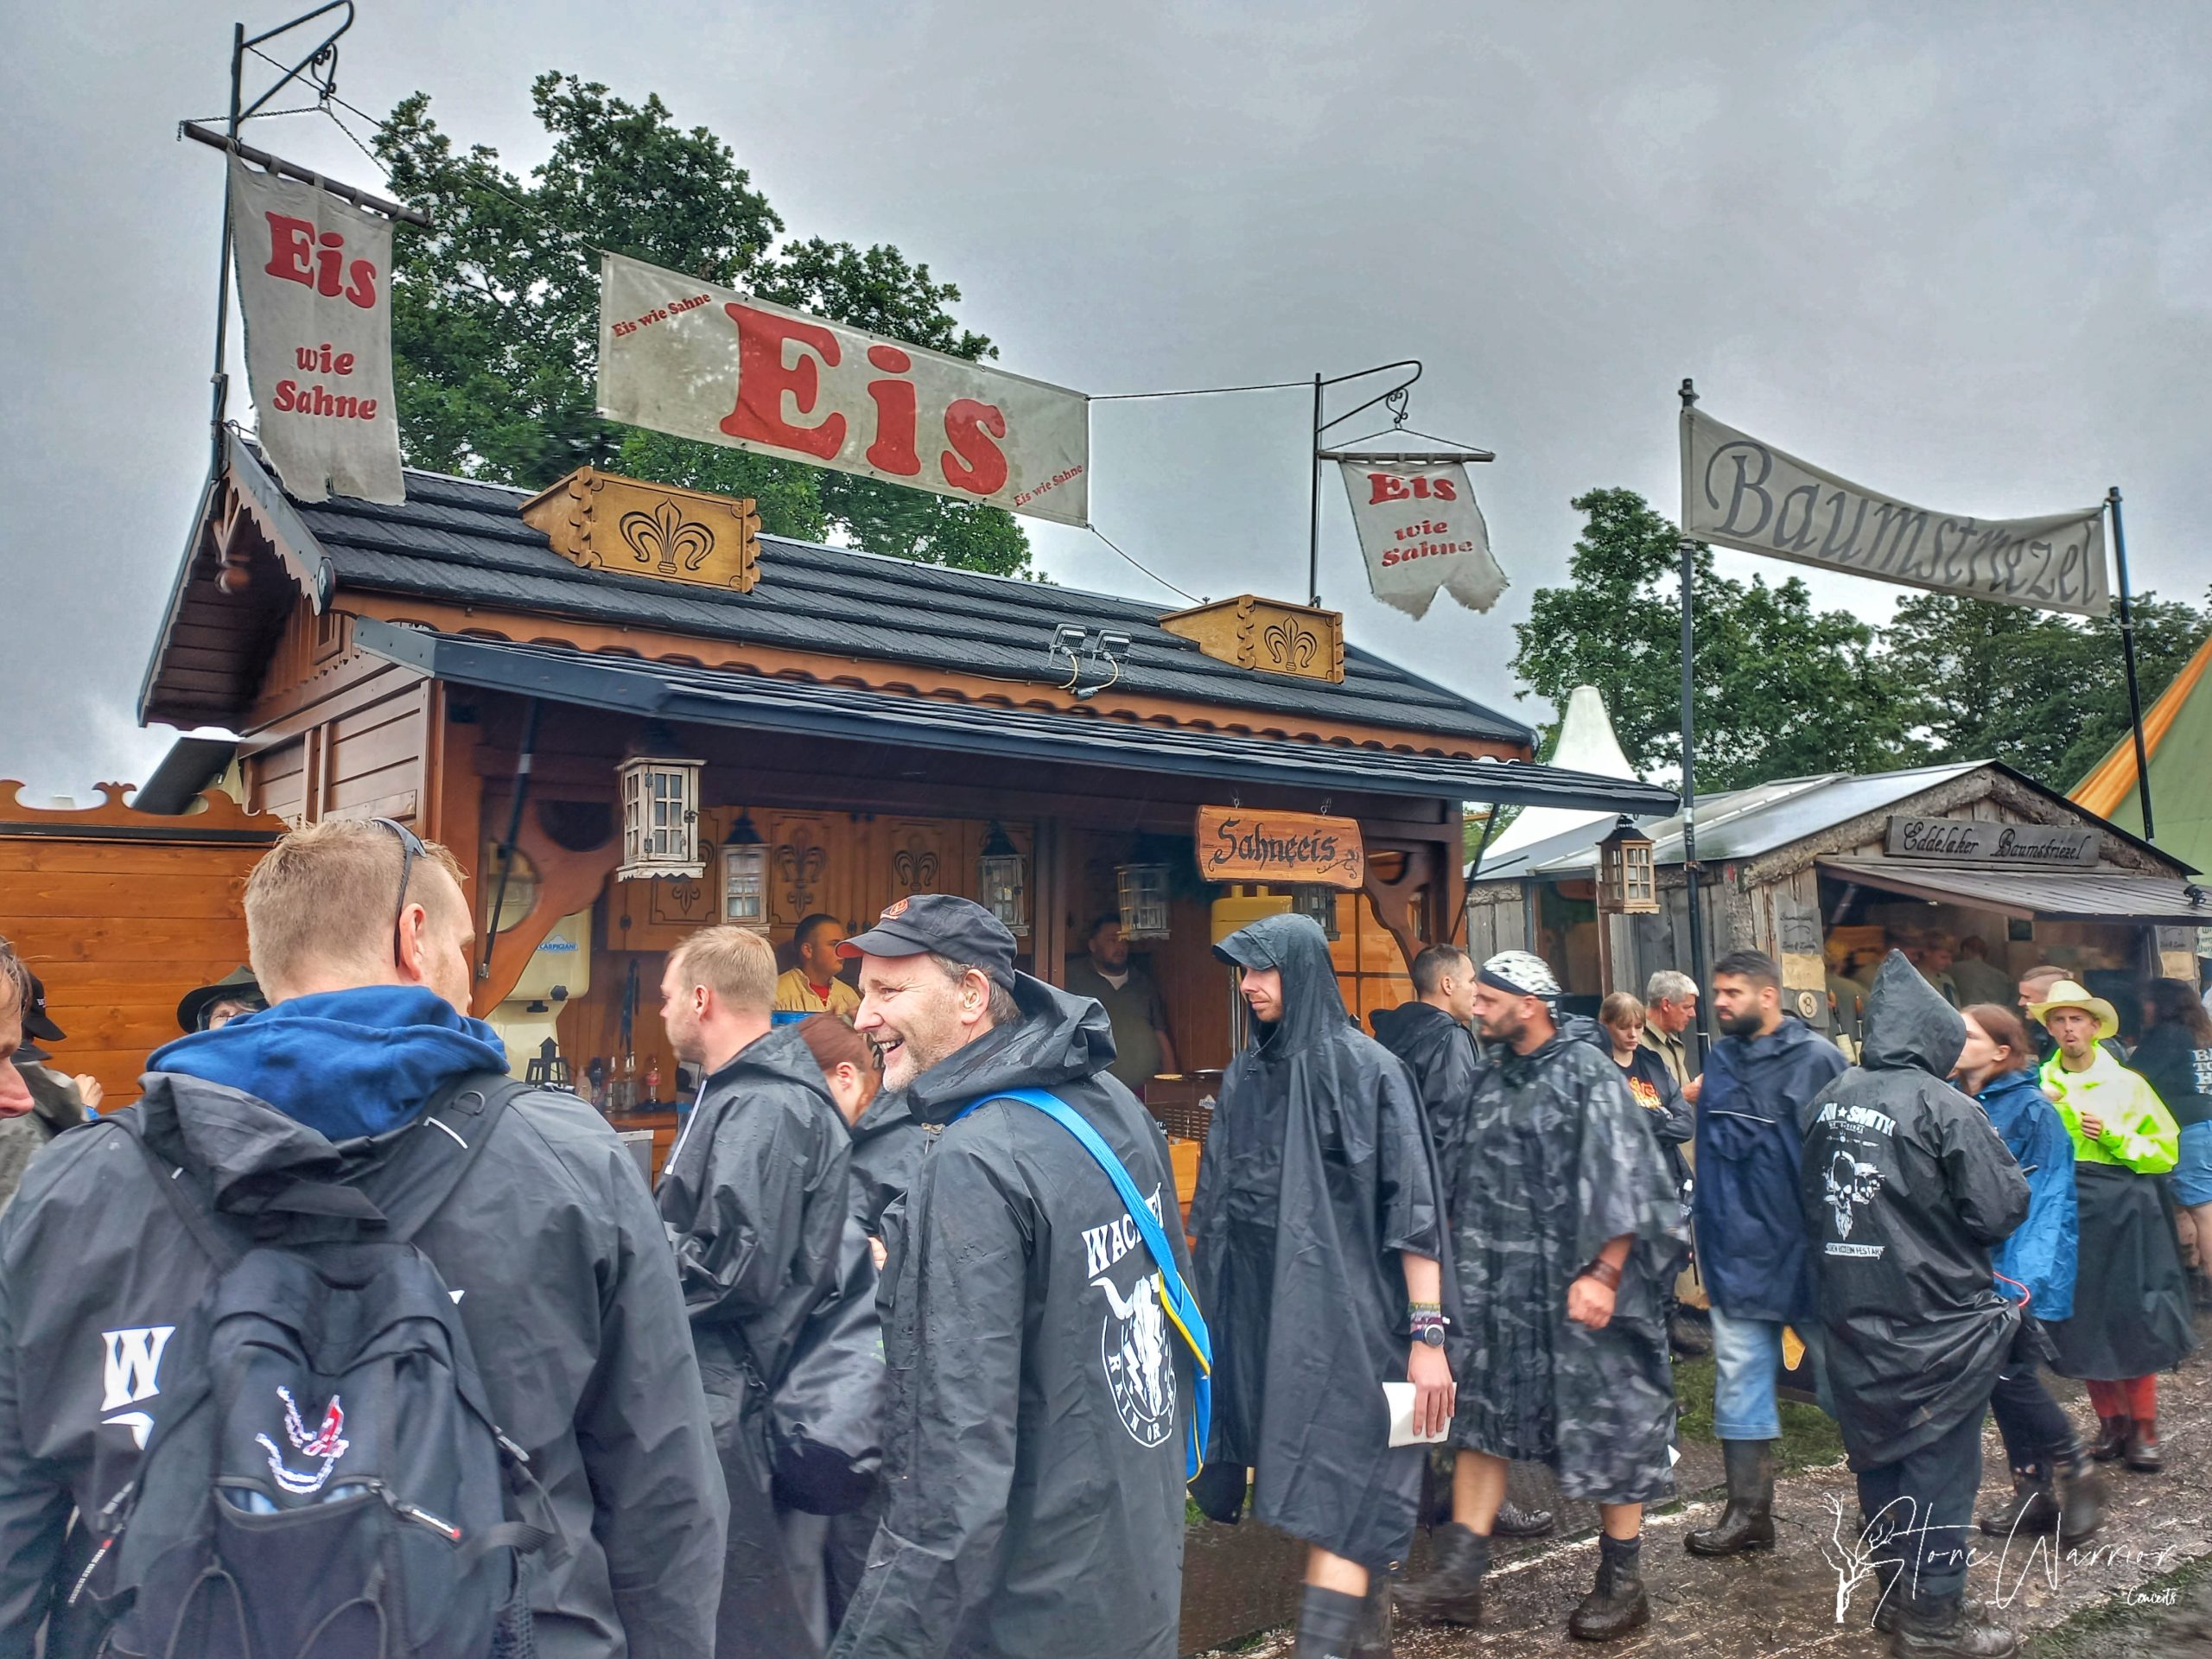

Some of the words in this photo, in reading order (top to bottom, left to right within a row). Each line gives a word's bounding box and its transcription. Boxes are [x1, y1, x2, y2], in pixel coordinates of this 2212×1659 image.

[264, 211, 377, 308] Eis
[611, 321, 637, 337] Eis
[638, 309, 667, 326] wie
[667, 294, 711, 315] Sahne
[295, 344, 354, 375] wie
[272, 379, 378, 420] Sahne
[720, 302, 1007, 495] Eis
[1013, 493, 1032, 507] Eis
[1032, 482, 1052, 496] wie
[1052, 465, 1083, 486] Sahne
[1367, 474, 1457, 505] Eis
[1394, 520, 1448, 540] wie
[1705, 441, 2097, 606] Baumstriezel
[1209, 817, 1338, 871] Sahneeis
[1990, 829, 2091, 860] Baumstriezel
